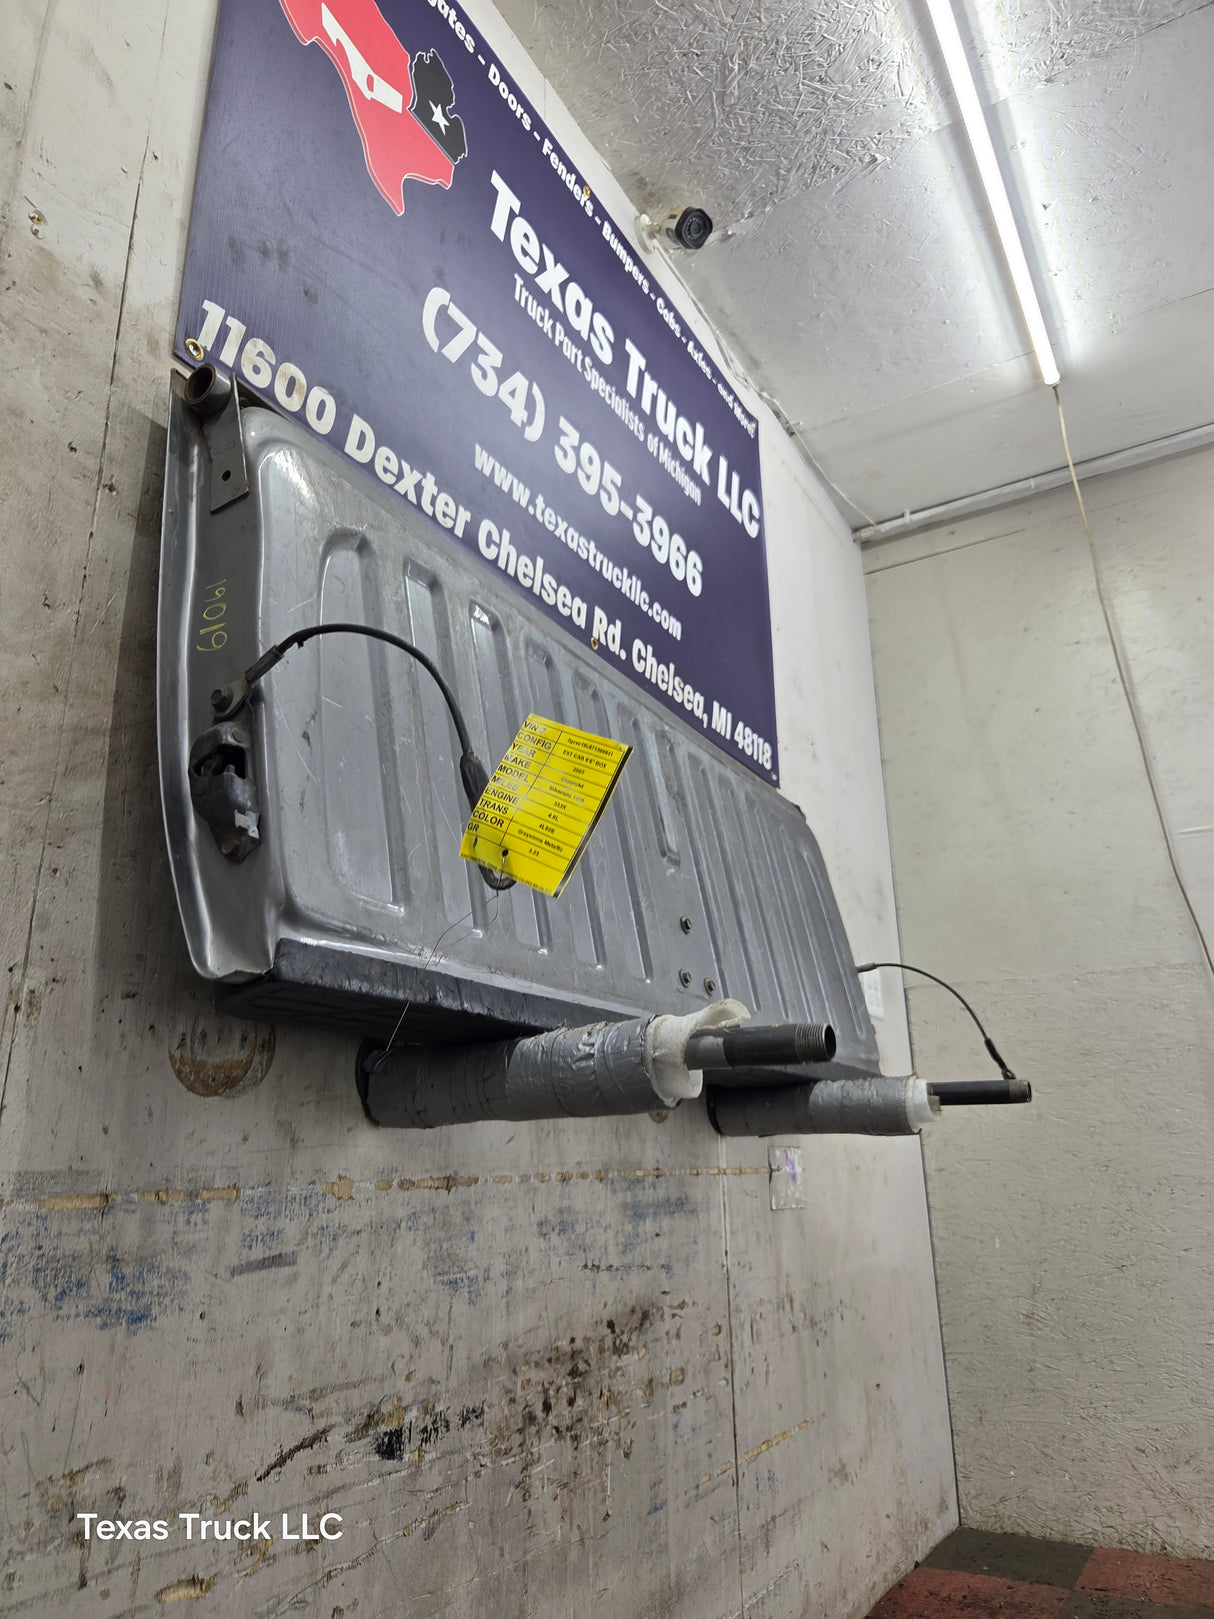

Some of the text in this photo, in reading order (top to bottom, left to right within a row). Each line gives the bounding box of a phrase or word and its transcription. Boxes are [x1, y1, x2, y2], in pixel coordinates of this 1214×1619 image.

[488, 63, 532, 131] Doors
[542, 138, 594, 217] Fenders
[602, 221, 650, 295] Bumpers
[656, 297, 682, 338] Cabs
[687, 340, 712, 380] Axles
[717, 383, 734, 410] and
[490, 169, 761, 539] Texas Truck LLC
[513, 272, 702, 507] Truck Part Specialists of Michigan
[422, 286, 703, 597] (734) 395-3966
[197, 299, 773, 770] 11600 Dexter Chelsea Rd. Chelsea, MI 48118
[474, 443, 682, 641] www.texastruckllc.com
[523, 720, 538, 732] VIN
[511, 742, 536, 758] YEAR
[517, 731, 552, 750] CONFIG
[504, 754, 532, 770] MAKE
[491, 775, 519, 791] MILES
[497, 764, 529, 783] MODEL
[484, 787, 519, 805] ENGINE
[479, 798, 509, 815] TRANS
[467, 822, 480, 833] GR
[472, 809, 504, 829] COLOR
